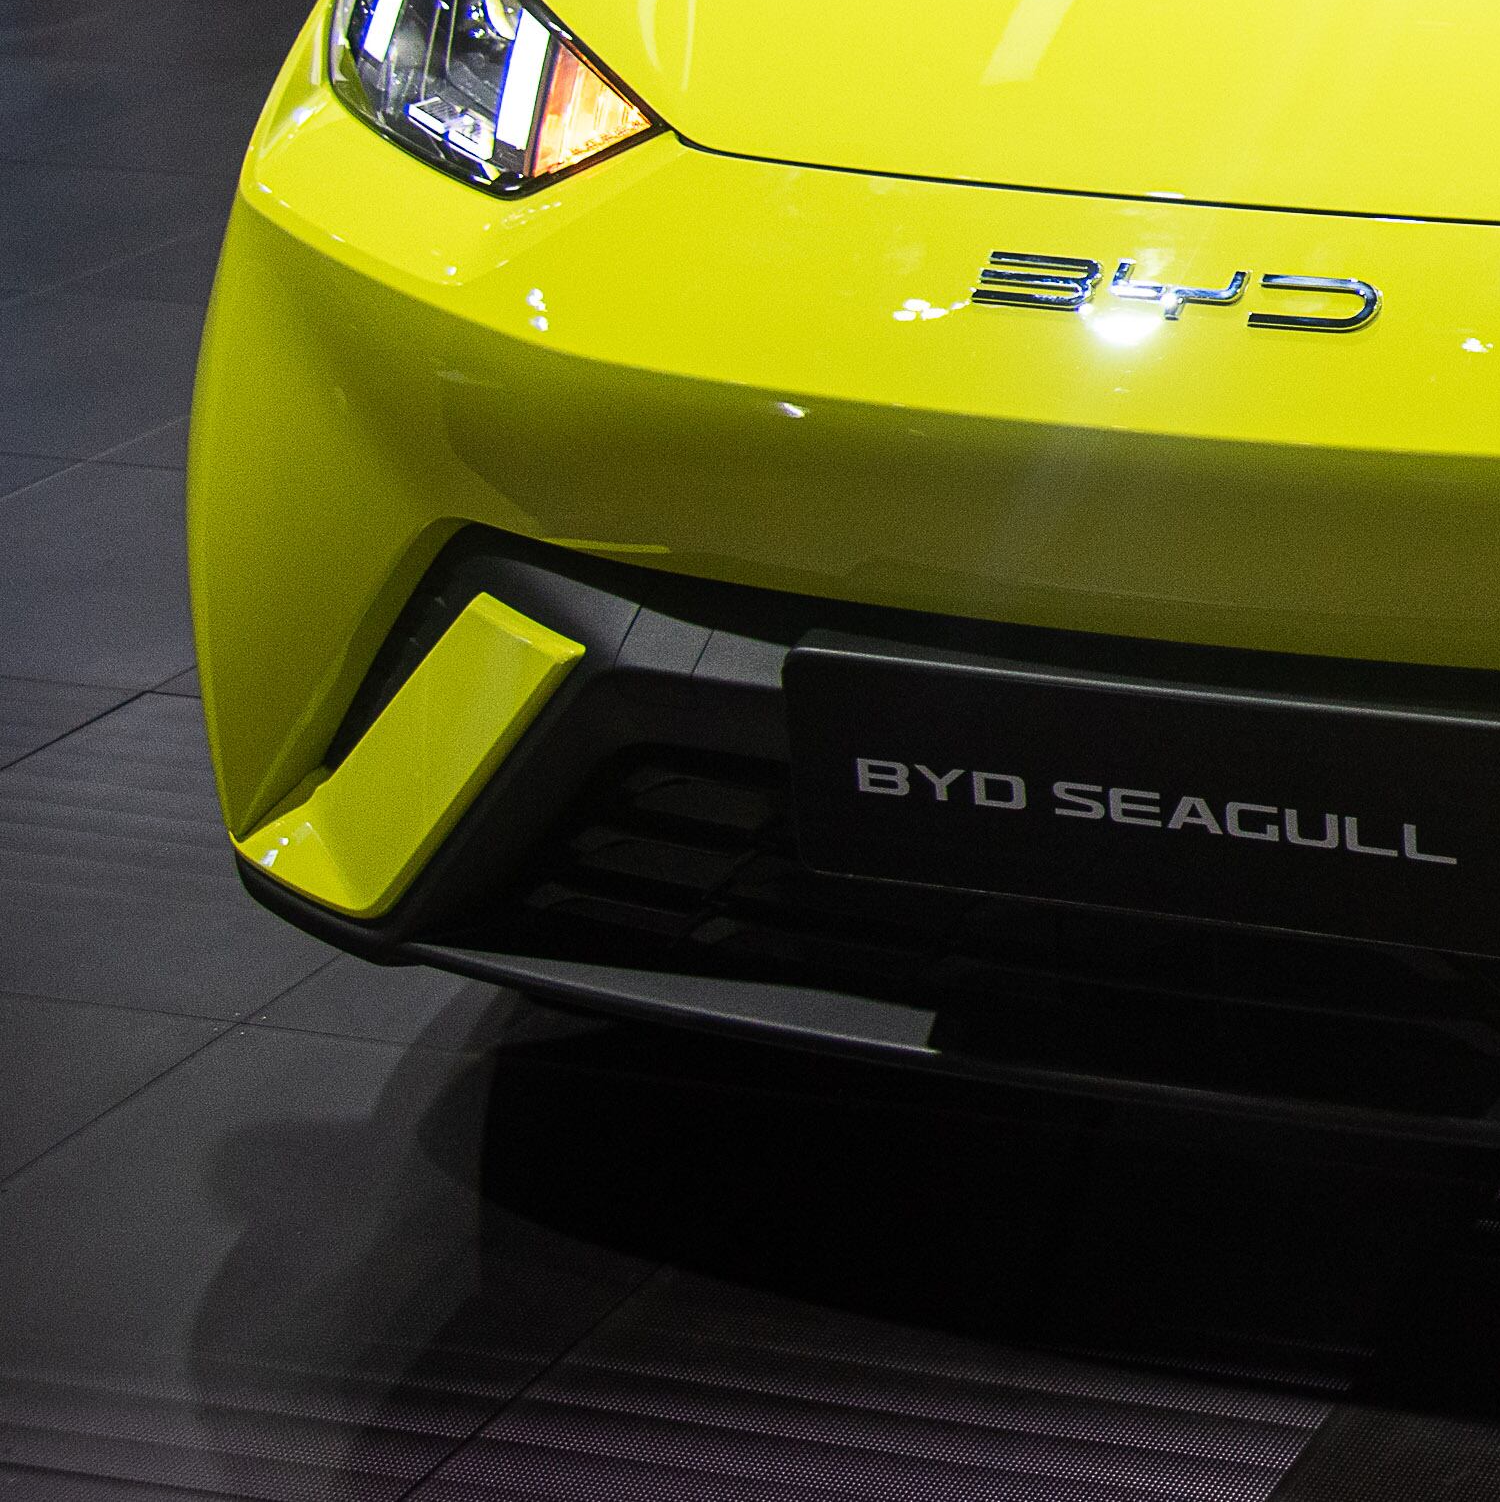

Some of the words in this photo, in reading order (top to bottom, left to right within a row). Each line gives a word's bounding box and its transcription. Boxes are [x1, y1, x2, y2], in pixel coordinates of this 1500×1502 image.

[971, 250, 1382, 333] BYD
[856, 758, 1026, 809] BYD
[1052, 781, 1457, 864] SEAGULL
